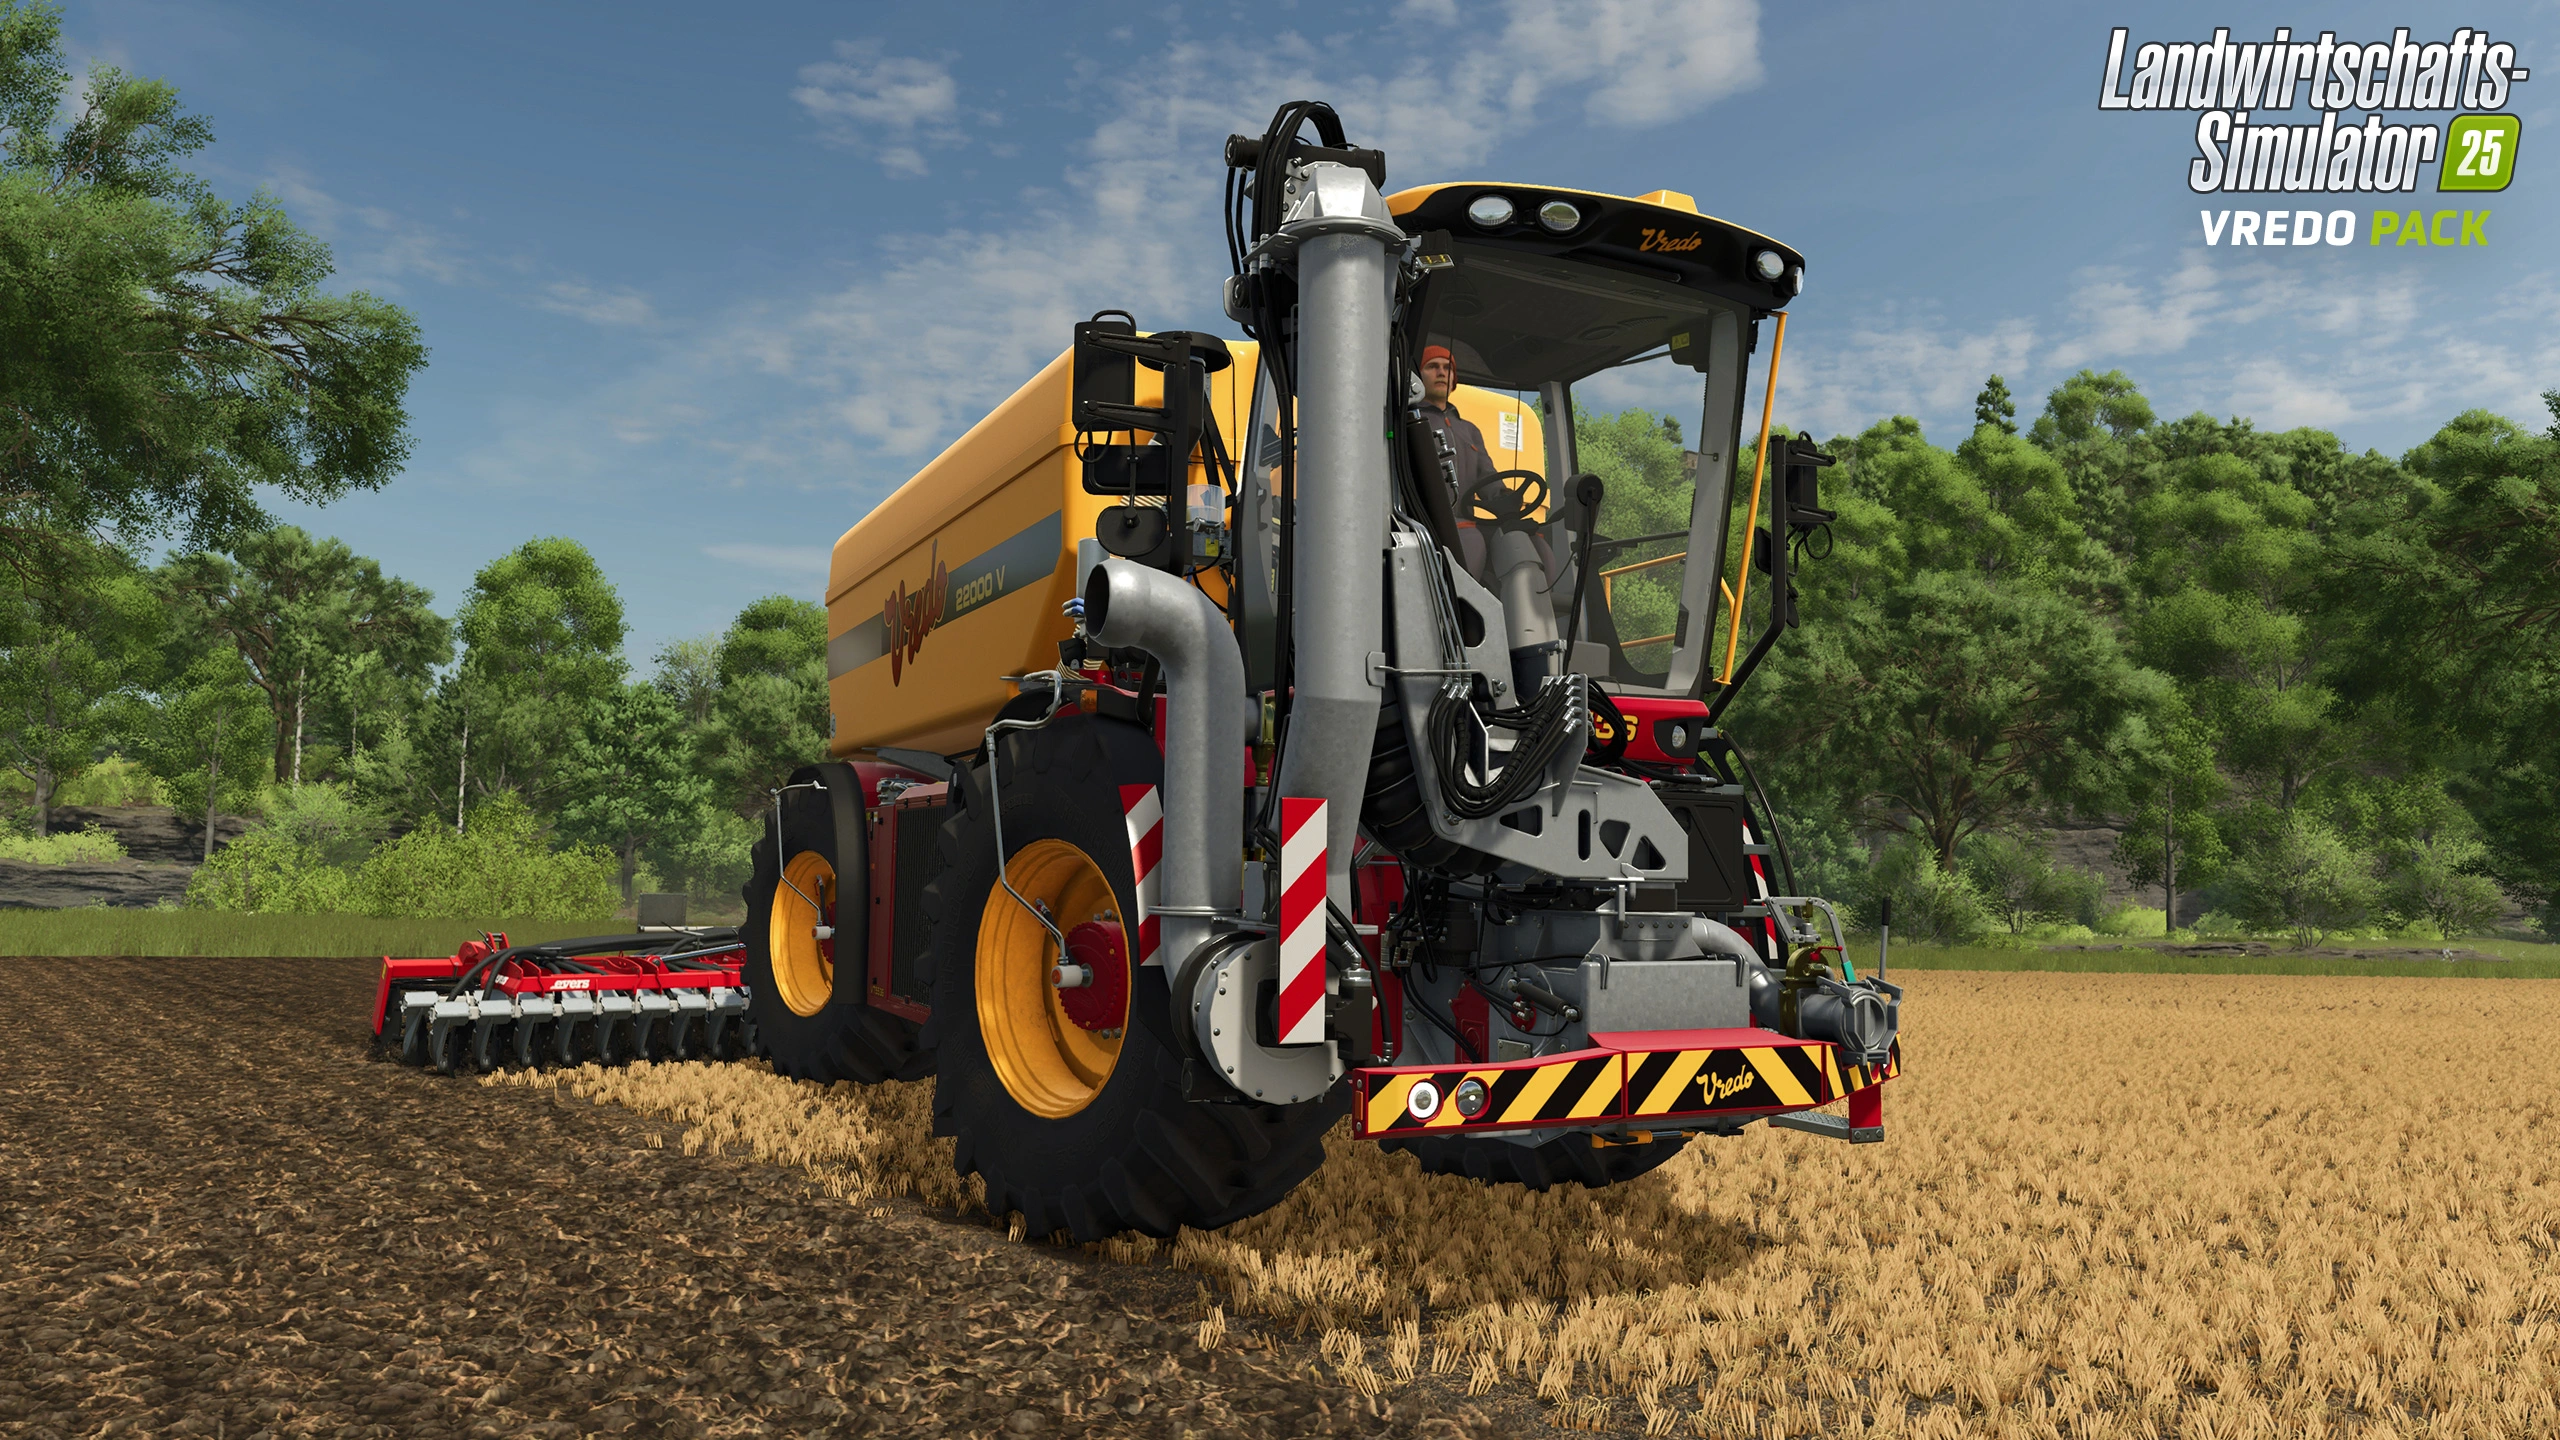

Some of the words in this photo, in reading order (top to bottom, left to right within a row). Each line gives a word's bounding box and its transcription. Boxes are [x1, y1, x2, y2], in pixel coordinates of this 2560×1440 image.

[1639, 227, 1702, 252] Vredo
[884, 537, 948, 687] Vredo
[955, 571, 993, 612] 22000
[995, 564, 1006, 591] V
[1696, 1064, 1754, 1105] Vredo
